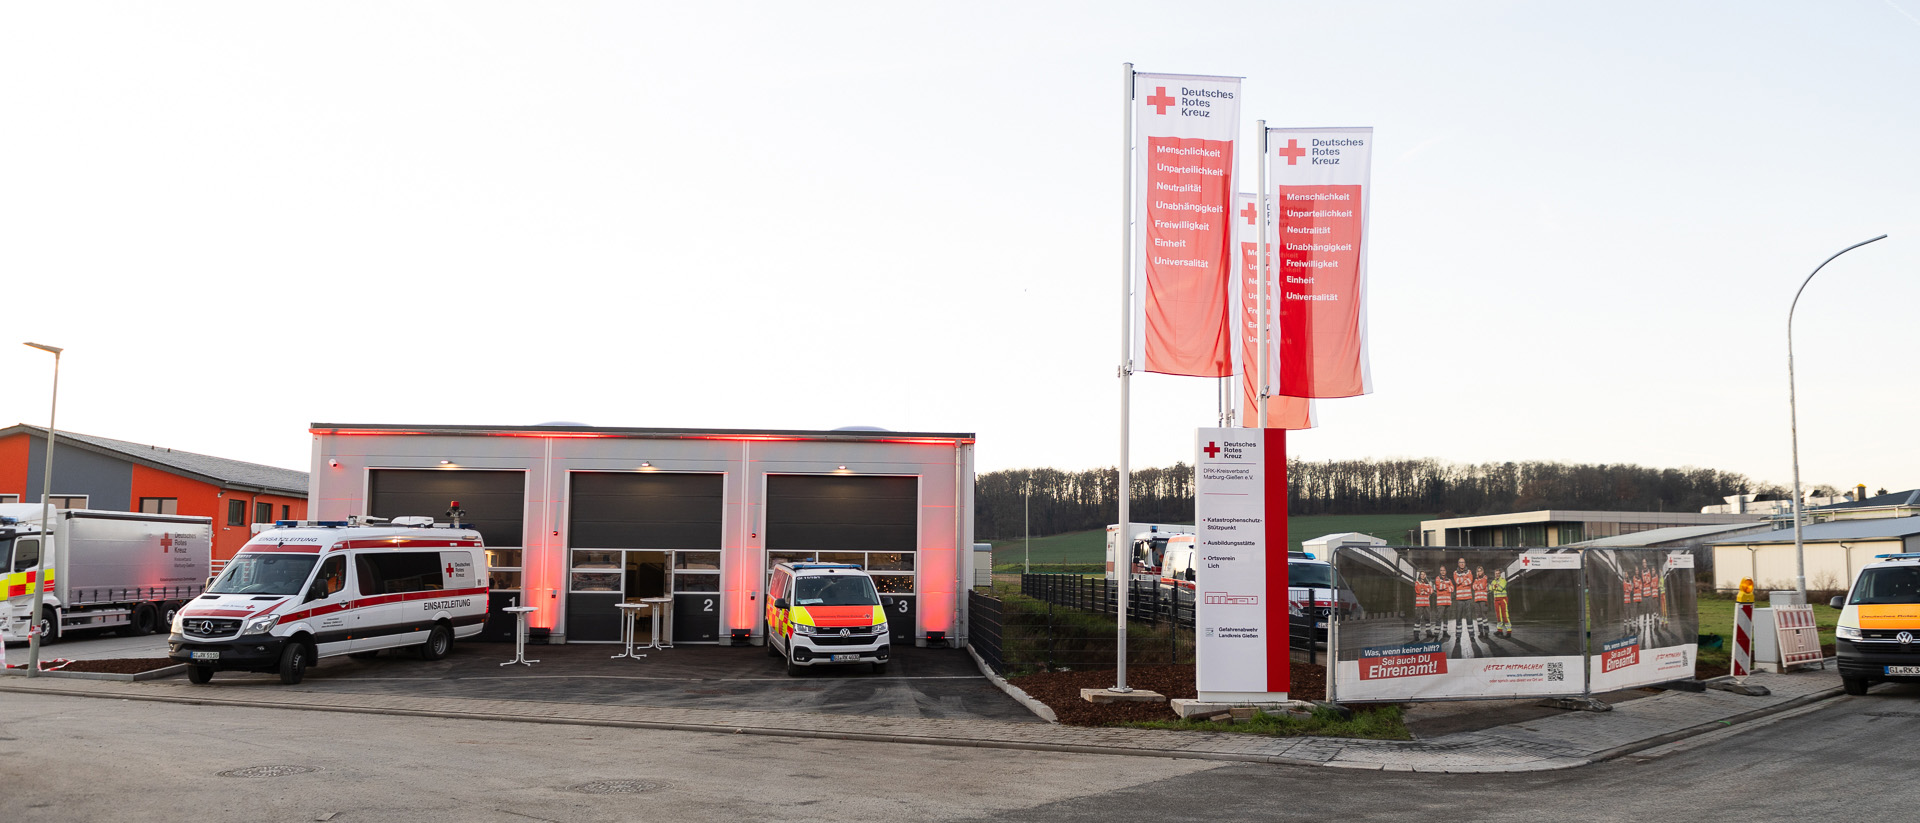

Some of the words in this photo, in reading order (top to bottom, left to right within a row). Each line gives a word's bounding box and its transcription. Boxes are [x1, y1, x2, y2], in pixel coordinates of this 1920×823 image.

[1181, 87, 1234, 99] Deutsches
[1181, 97, 1210, 108] Rotes
[1181, 108, 1210, 118] Kreuz
[1312, 138, 1364, 147] Deutsches
[1156, 145, 1220, 157] Menschlichkeit
[1312, 148, 1340, 156] Rotes
[1312, 157, 1340, 165] Kreuz
[1157, 163, 1224, 176] Unparteilichkeit
[1156, 182, 1202, 192] Neutralität
[1286, 193, 1350, 201] Menschlichkeit
[1155, 200, 1223, 213] Unabhängigkeit
[1287, 209, 1352, 218] Unparteilichkeit
[1154, 220, 1210, 231] Freiwilligkeit
[1287, 226, 1331, 234] Neutralität
[1154, 238, 1186, 248] Einheit
[1286, 243, 1352, 252] Unabhängigkeit
[1154, 256, 1209, 268] Universalität
[1286, 259, 1338, 269] Freiwilligkeit
[1286, 275, 1314, 284] Einheit
[1286, 292, 1338, 301] Universalität
[423, 599, 471, 611] EINSATZLEITUNG
[509, 596, 516, 607] 1
[703, 598, 713, 611] 2
[898, 600, 908, 613] 3
[1364, 649, 1381, 657] Was,
[1401, 646, 1422, 654] keiner
[1423, 645, 1440, 653] hilft?
[1382, 657, 1394, 666] Sei
[1396, 656, 1416, 665] auch
[1418, 655, 1431, 663] DU
[1369, 661, 1437, 679] Ehrenamt!
[1483, 664, 1505, 672] JETZT
[1903, 666, 1914, 674] RK
